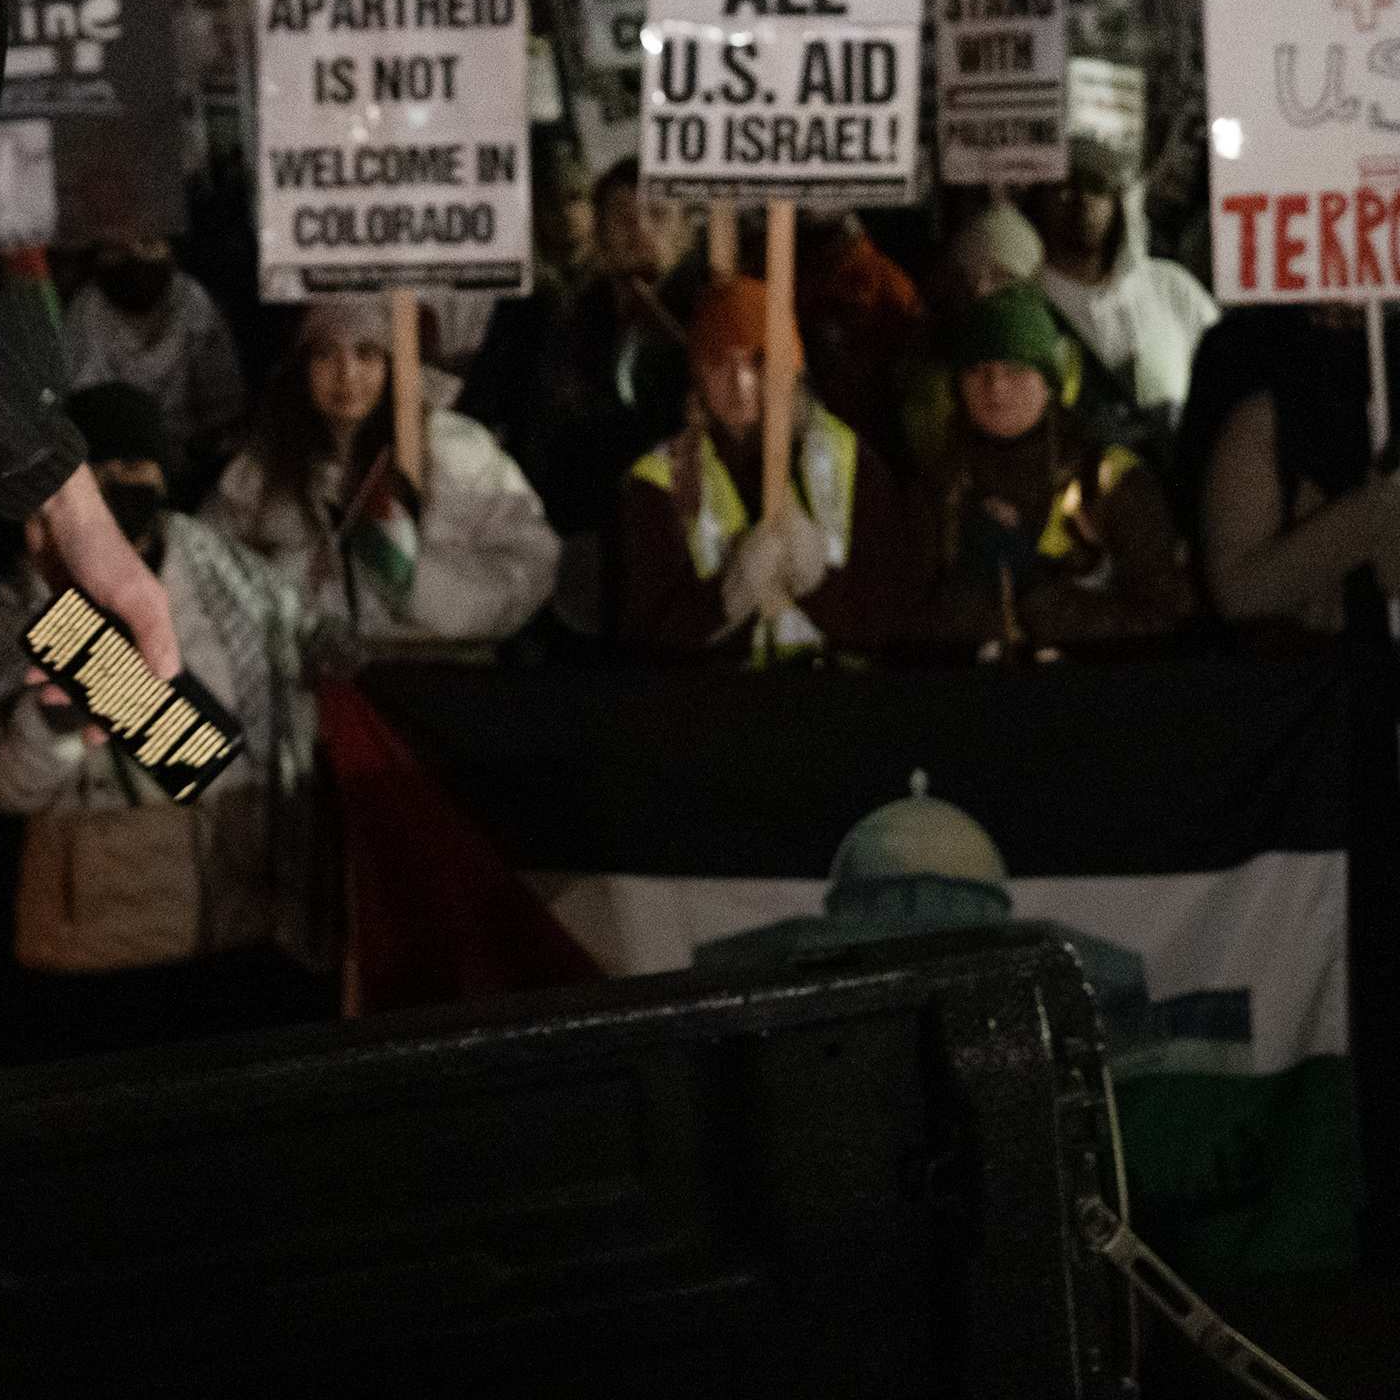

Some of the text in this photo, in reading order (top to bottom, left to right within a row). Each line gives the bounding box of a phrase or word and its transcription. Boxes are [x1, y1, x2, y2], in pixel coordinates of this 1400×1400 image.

[314, 56, 460, 102] IS NOT
[660, 39, 896, 104] U.S. AID
[652, 114, 898, 165] TO ISRAEL!
[269, 142, 517, 189] WELCOME IN
[293, 203, 496, 248] COLORADO
